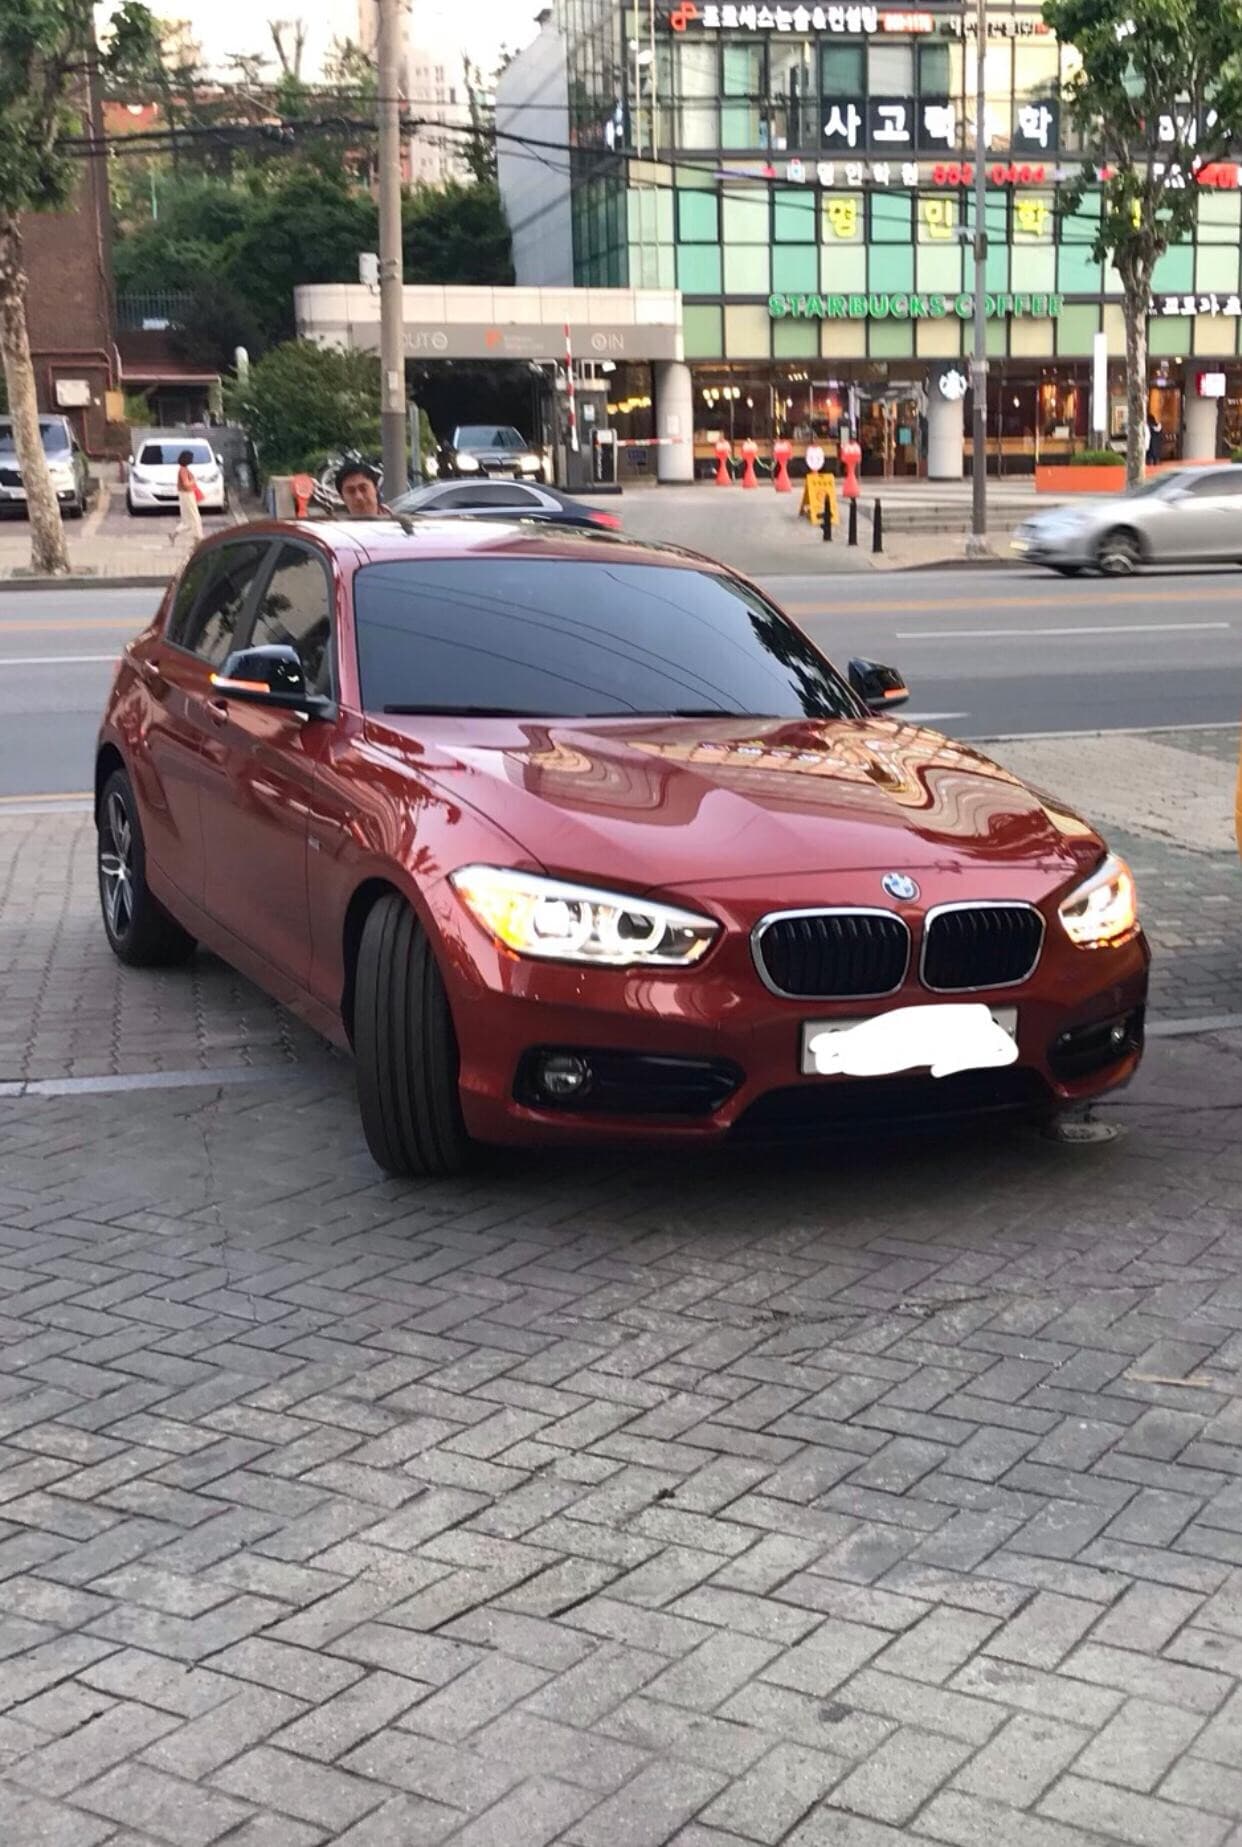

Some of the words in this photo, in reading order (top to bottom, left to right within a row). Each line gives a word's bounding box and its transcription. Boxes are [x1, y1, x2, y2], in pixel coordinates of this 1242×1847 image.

[824, 104, 1052, 148] 사고력학
[768, 294, 946, 319] STARBUCKS
[955, 293, 1064, 319] COFFEE
[608, 333, 624, 351] IN
